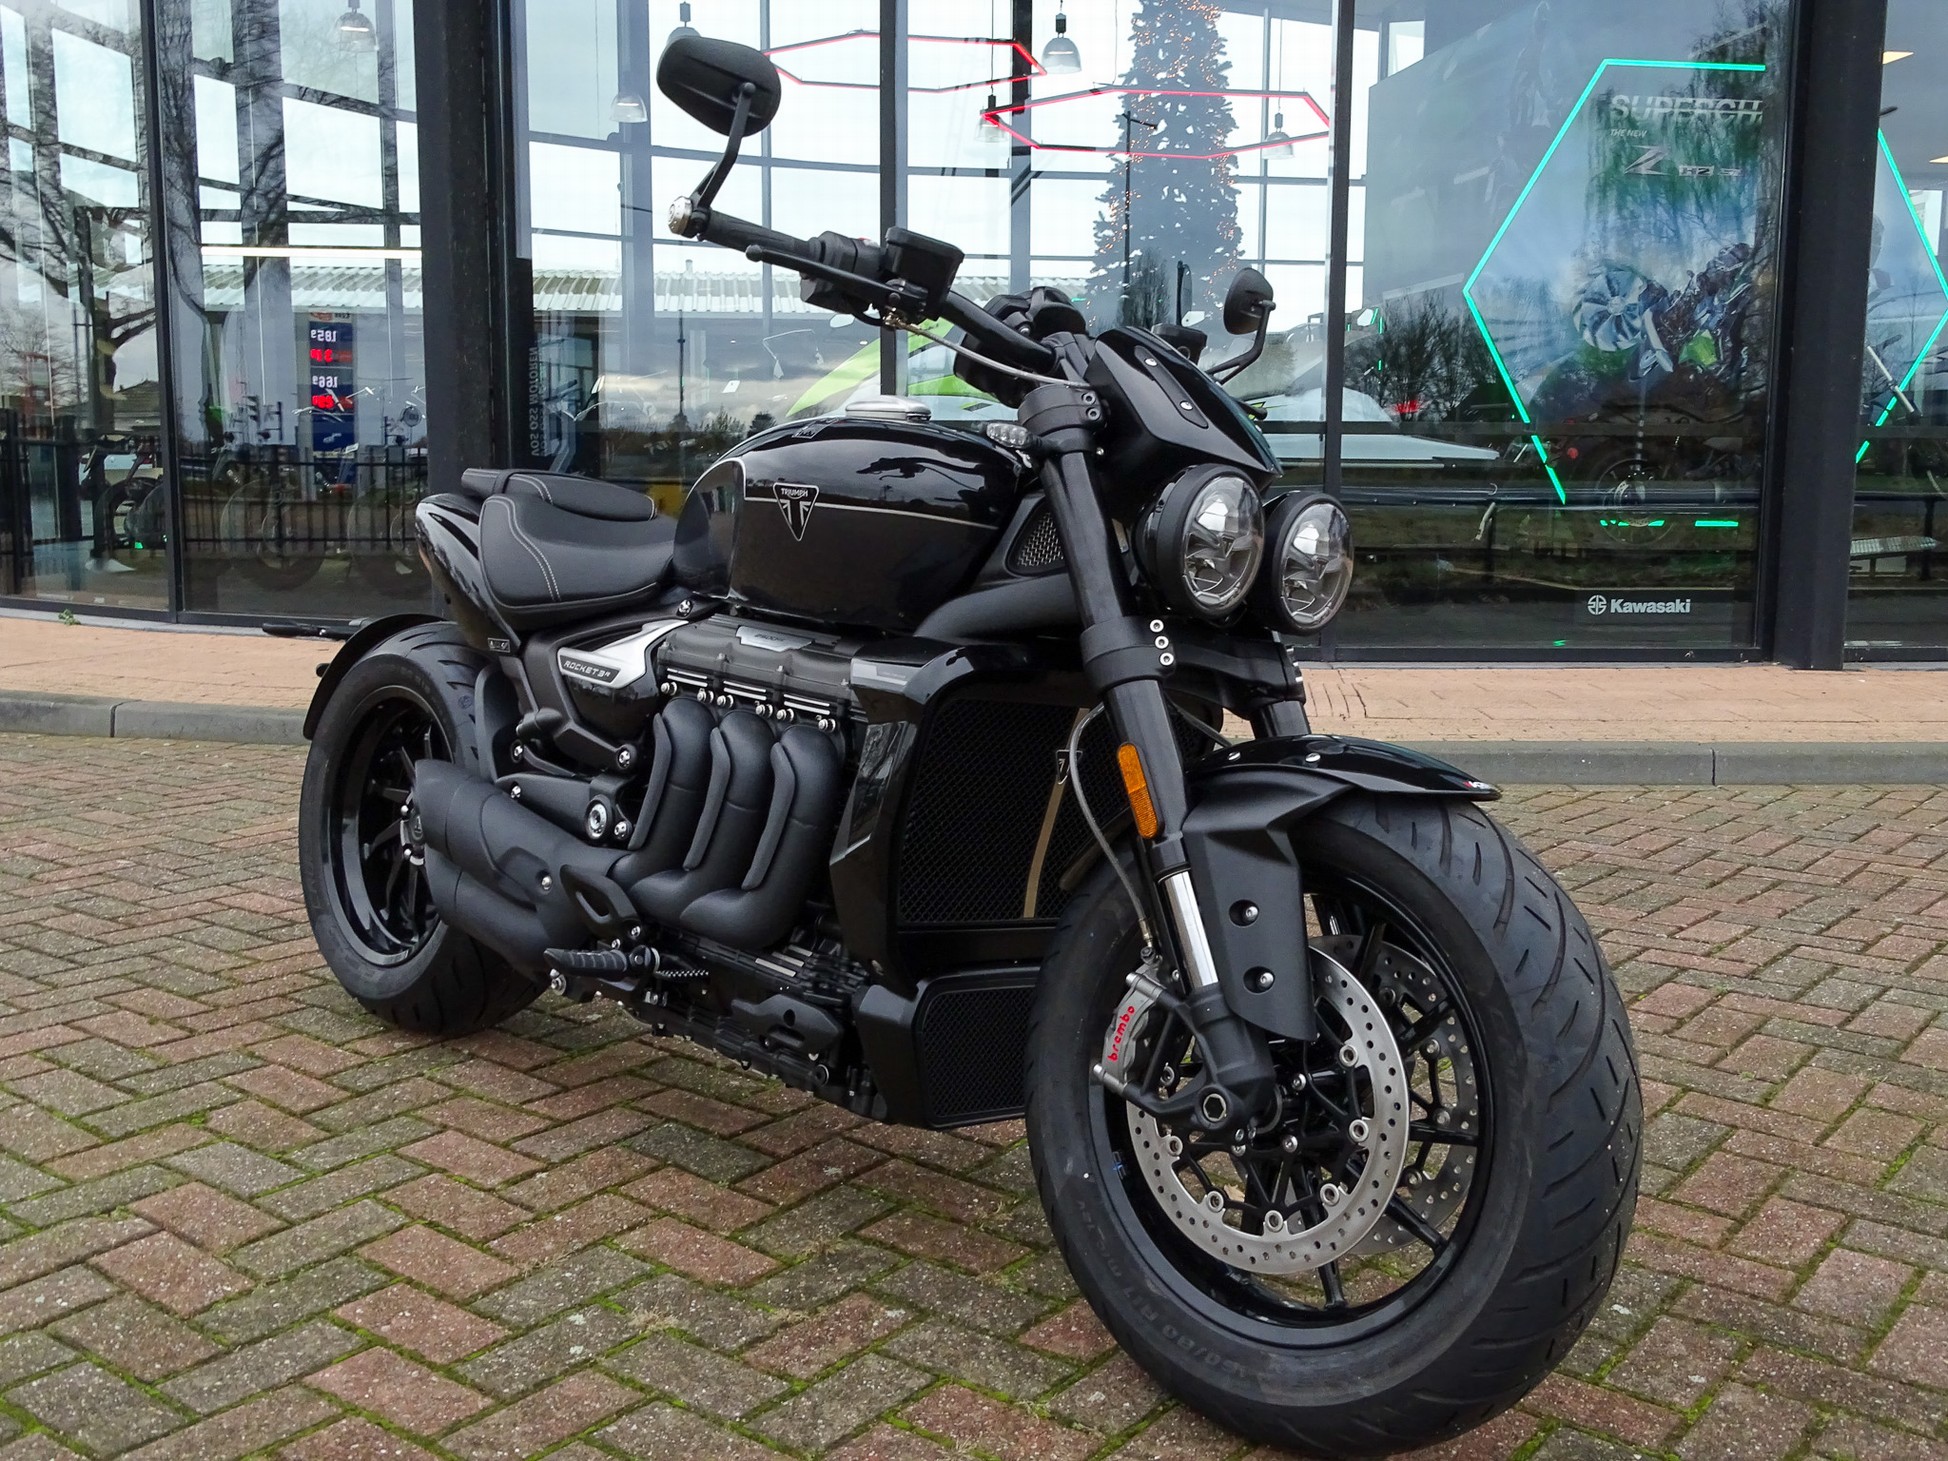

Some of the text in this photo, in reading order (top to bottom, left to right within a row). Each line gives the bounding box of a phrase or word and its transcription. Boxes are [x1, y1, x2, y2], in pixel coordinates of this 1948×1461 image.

[1610, 95, 1763, 124] SUPERCH
[1610, 129, 1648, 138] THE NEW
[781, 487, 808, 499] TRIUMPH
[1610, 599, 1691, 613] Kawasaki
[1107, 1006, 1135, 1062] brembo
